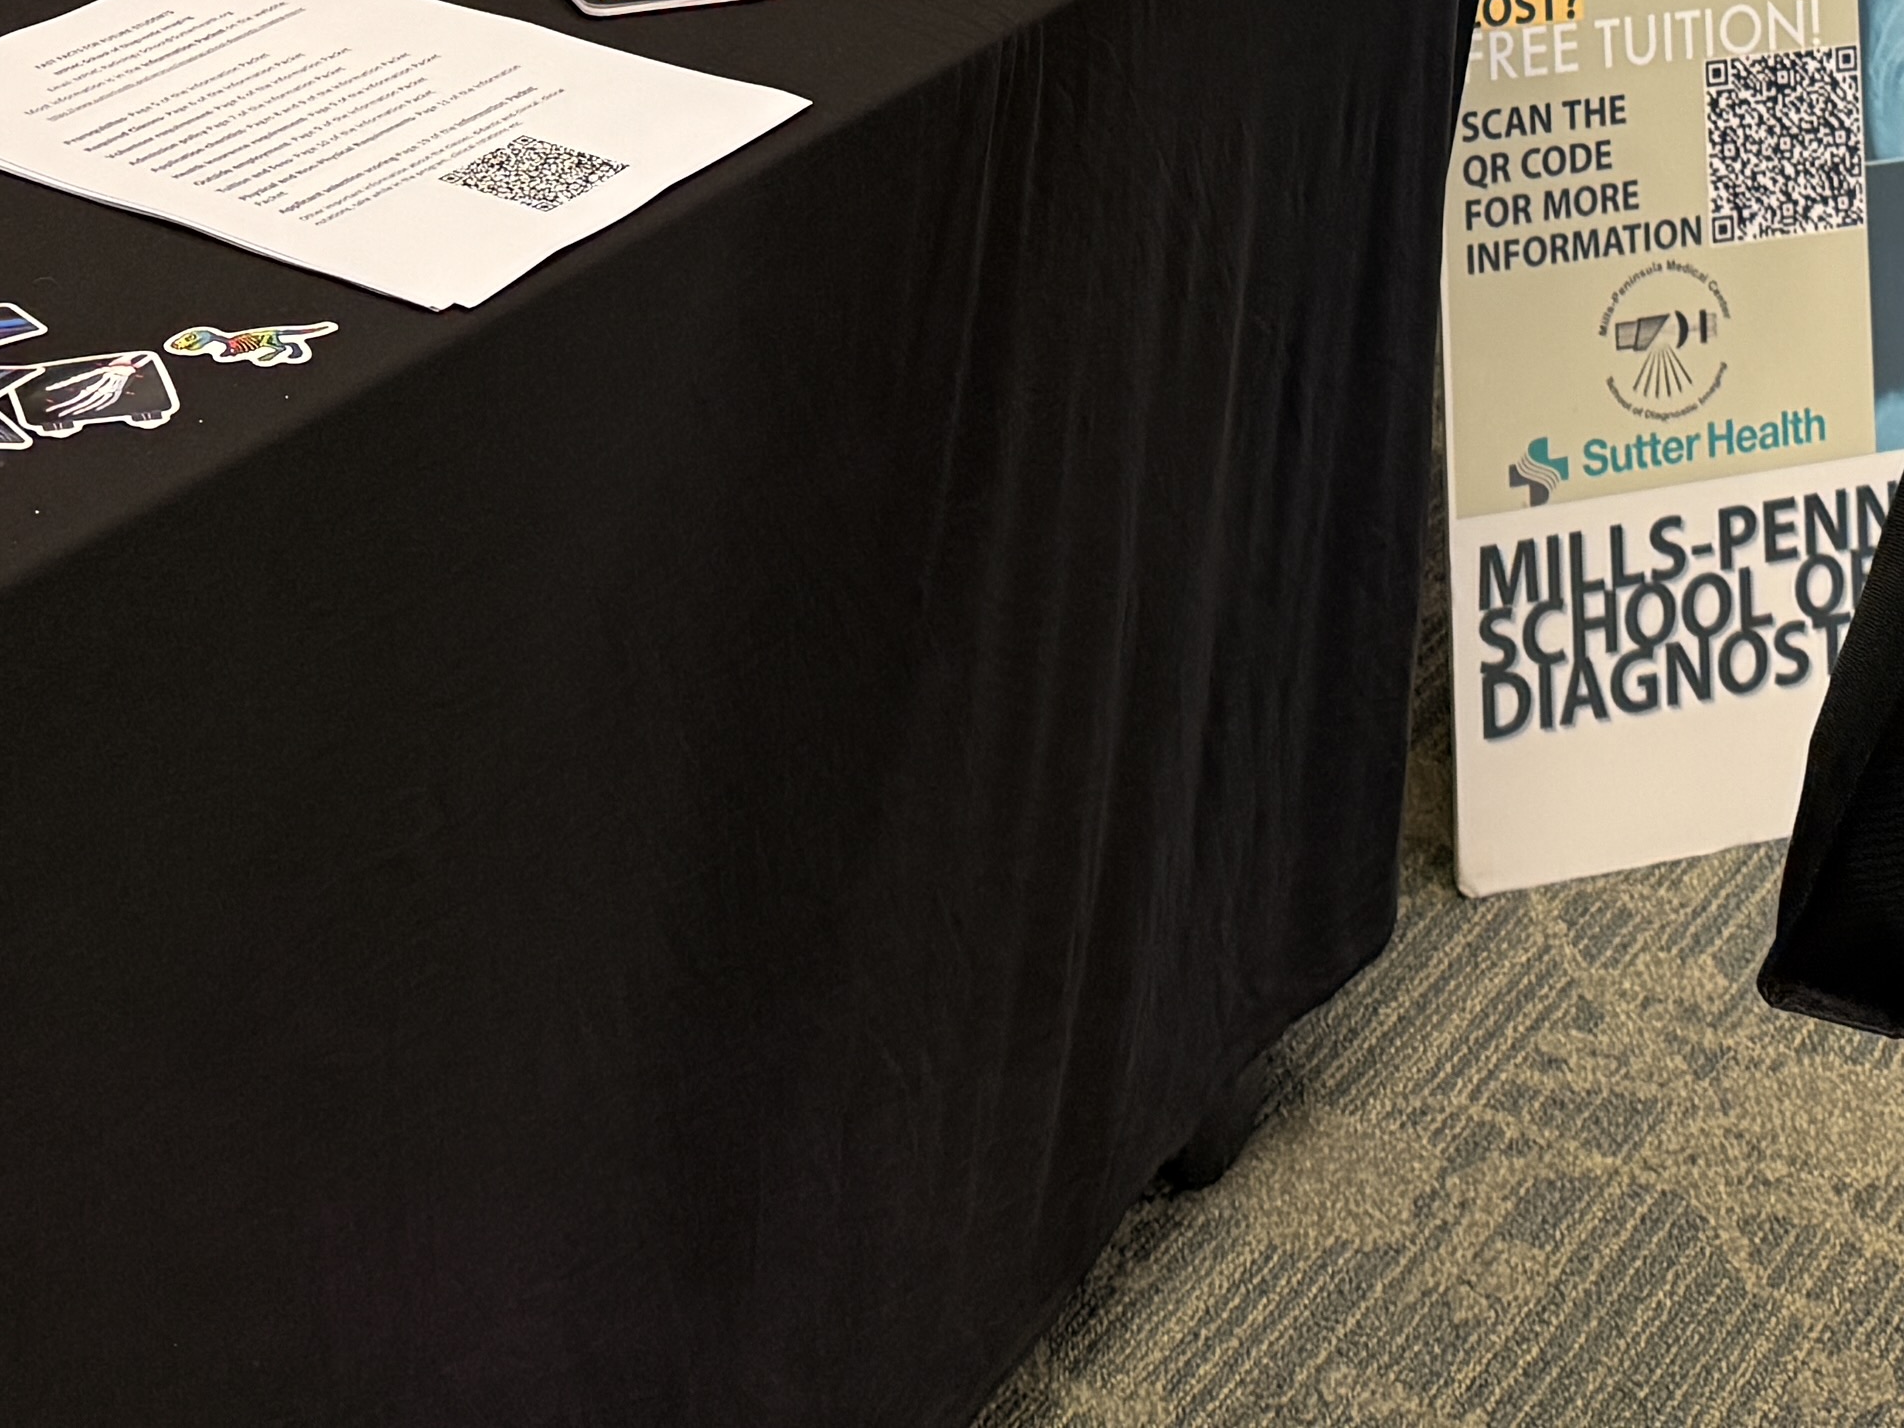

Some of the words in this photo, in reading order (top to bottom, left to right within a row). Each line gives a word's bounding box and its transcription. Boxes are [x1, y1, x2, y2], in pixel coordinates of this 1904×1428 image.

[1466, 23, 1579, 83] FREE
[1462, 109, 1553, 142] SCAN
[1561, 94, 1626, 129] THE
[1463, 152, 1510, 188] QR
[1521, 139, 1611, 178] CODE
[1465, 193, 1531, 230] FOR
[1543, 179, 1638, 220] MORE
[1467, 215, 1701, 274] INFORMATION
[1582, 433, 1699, 477] Sutter
[1707, 408, 1826, 457] Health
[1480, 566, 1773, 677] SCHOOL
